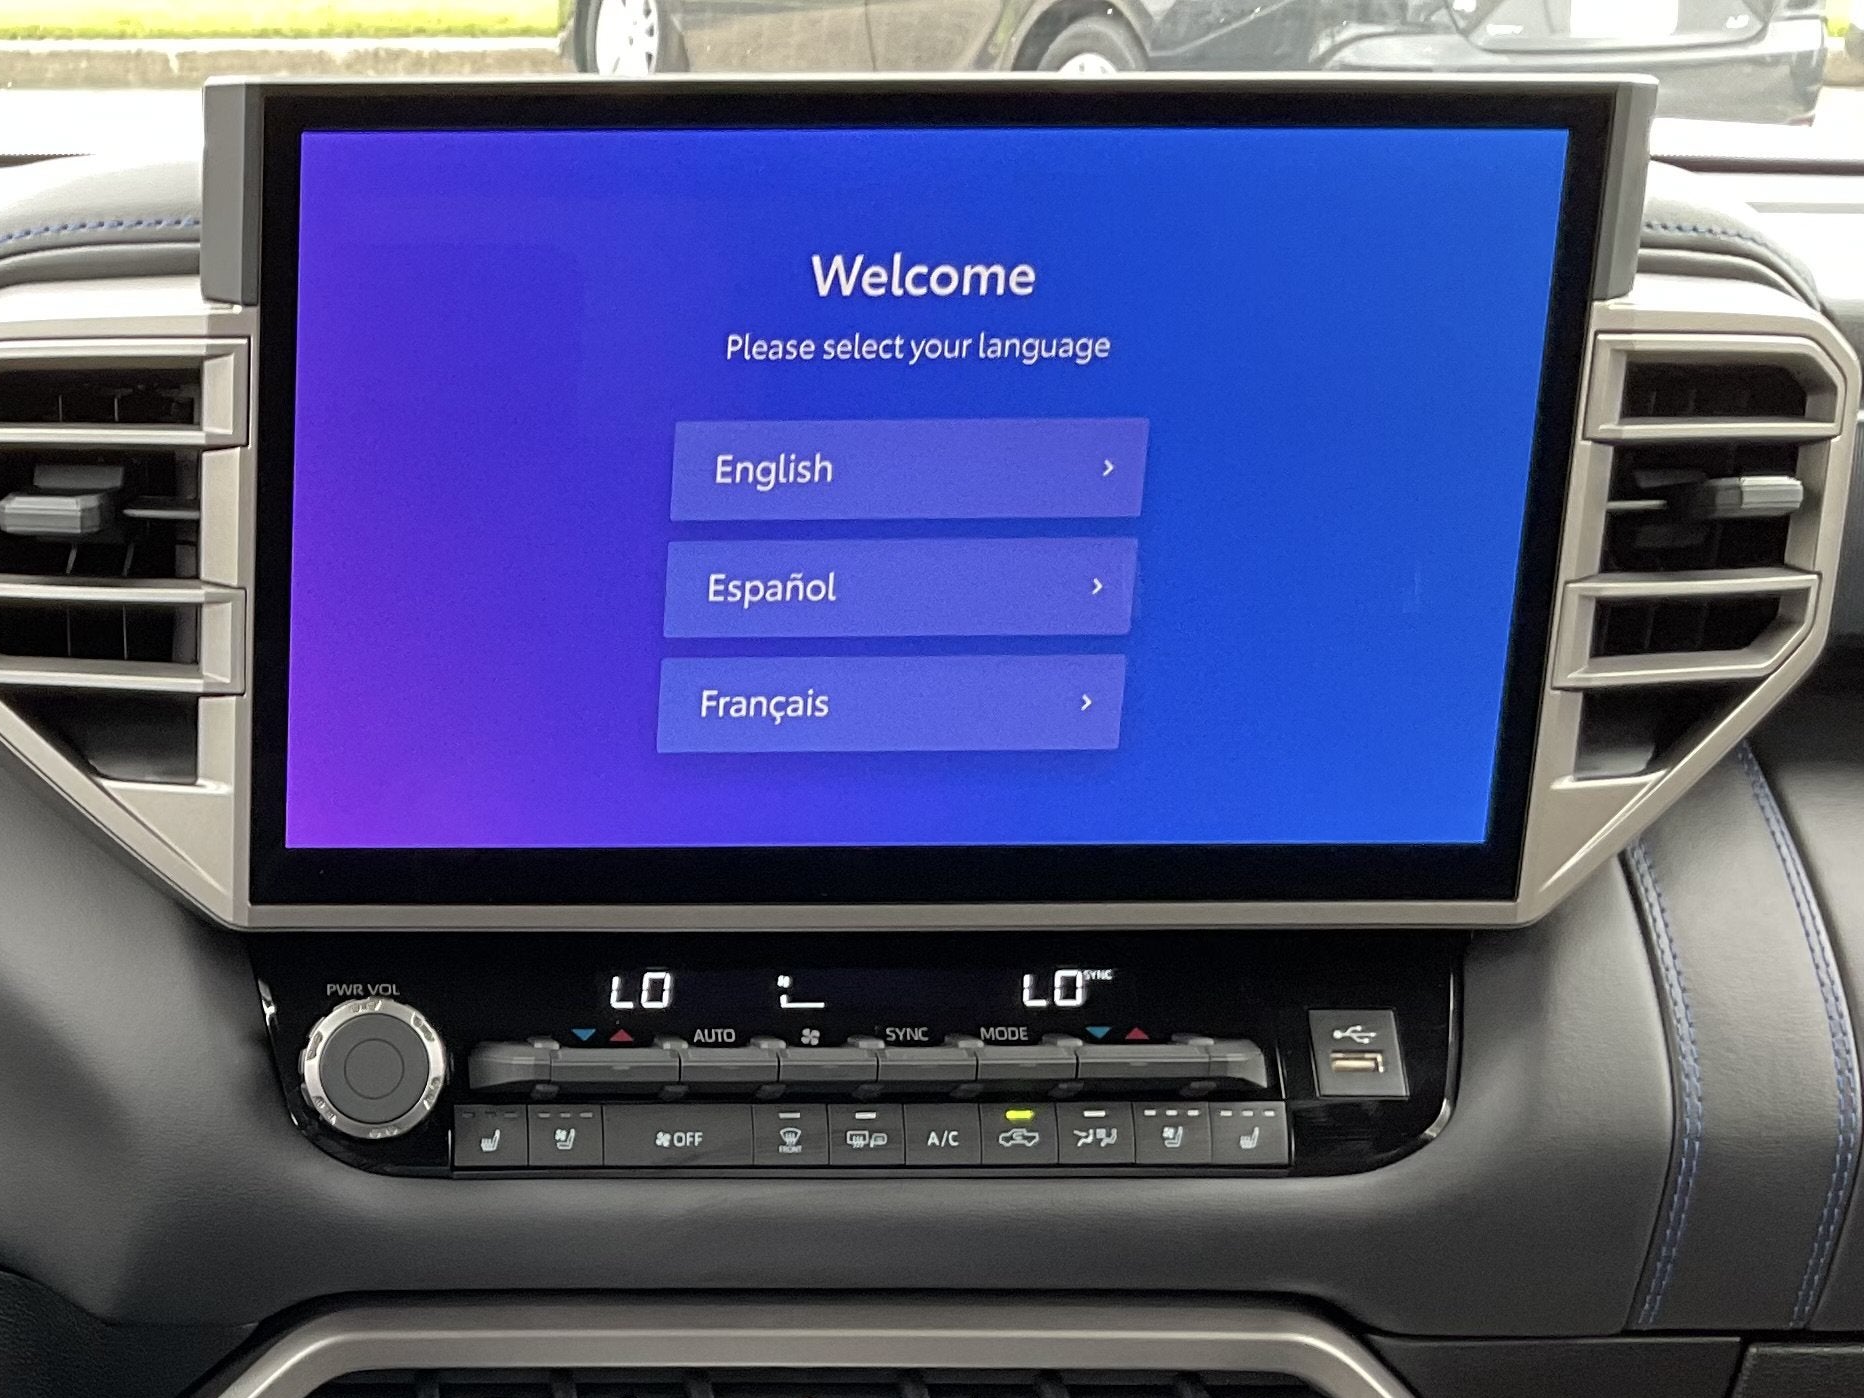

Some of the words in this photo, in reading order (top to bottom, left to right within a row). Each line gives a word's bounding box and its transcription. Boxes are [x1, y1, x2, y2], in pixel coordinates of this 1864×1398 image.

[811, 252, 1036, 298] Welcome
[726, 334, 815, 361] Please
[822, 333, 904, 361] select
[909, 339, 973, 365] your
[978, 332, 1112, 365] language
[714, 453, 833, 491] English
[707, 572, 836, 609] Español
[699, 688, 830, 725] Français
[326, 983, 364, 997] PWR
[366, 983, 401, 997] VOL
[609, 971, 672, 1009] LO
[1022, 969, 1084, 1007] LO
[1083, 969, 1113, 981] SYNC
[693, 1028, 736, 1043] AUTO
[885, 1027, 929, 1042] SYNC
[980, 1027, 1029, 1042] MODE
[673, 1131, 704, 1147] OFF
[927, 1130, 960, 1147] A/C
